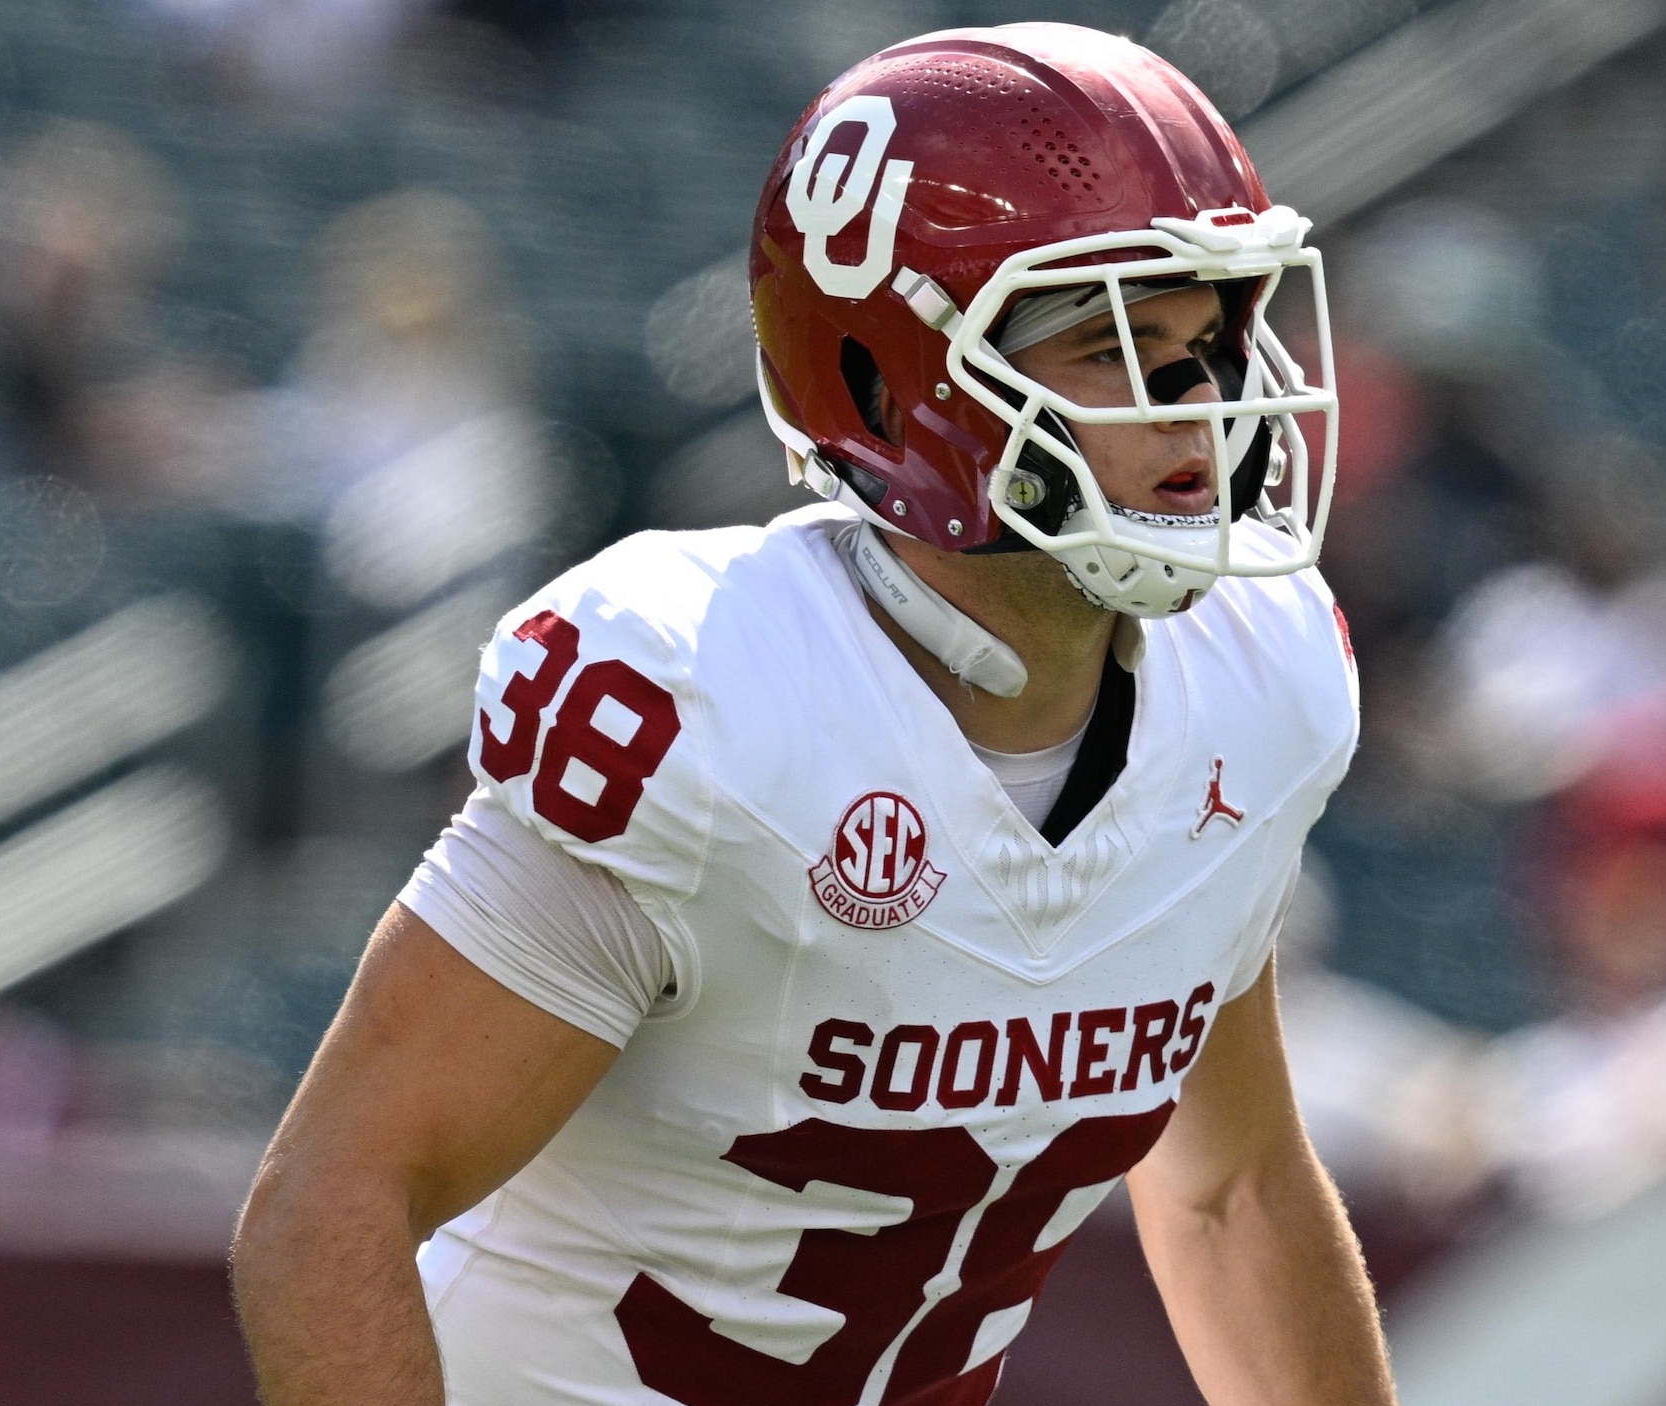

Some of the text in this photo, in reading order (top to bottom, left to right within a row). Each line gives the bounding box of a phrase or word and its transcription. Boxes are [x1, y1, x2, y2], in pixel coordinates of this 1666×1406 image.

[786, 95, 913, 299] OU
[479, 609, 681, 844] 38
[822, 884, 925, 926] GRADUATE
[841, 797, 921, 893] SEC
[799, 980, 1215, 1111] SOONERS
